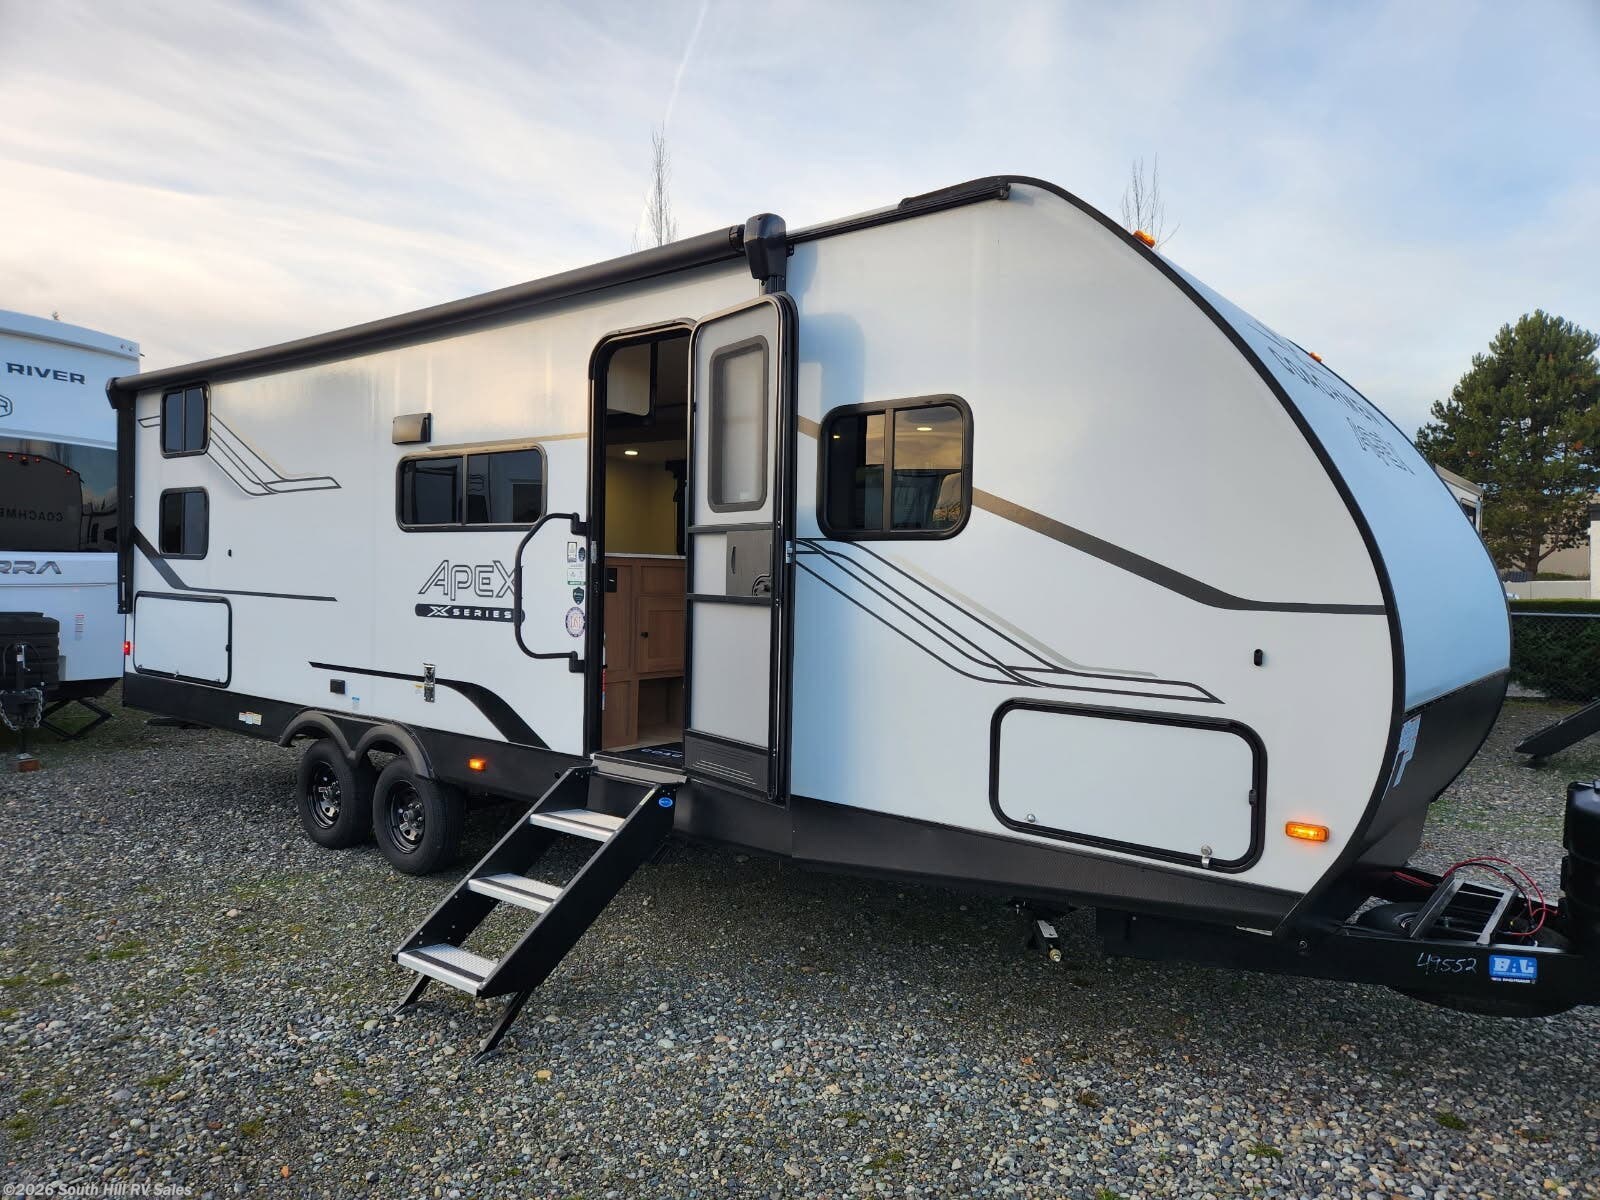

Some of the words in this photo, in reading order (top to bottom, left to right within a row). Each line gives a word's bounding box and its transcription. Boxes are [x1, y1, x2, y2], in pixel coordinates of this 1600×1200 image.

[6, 362, 86, 385] RIVER
[417, 559, 516, 602] APEX
[452, 608, 513, 619] SERIES
